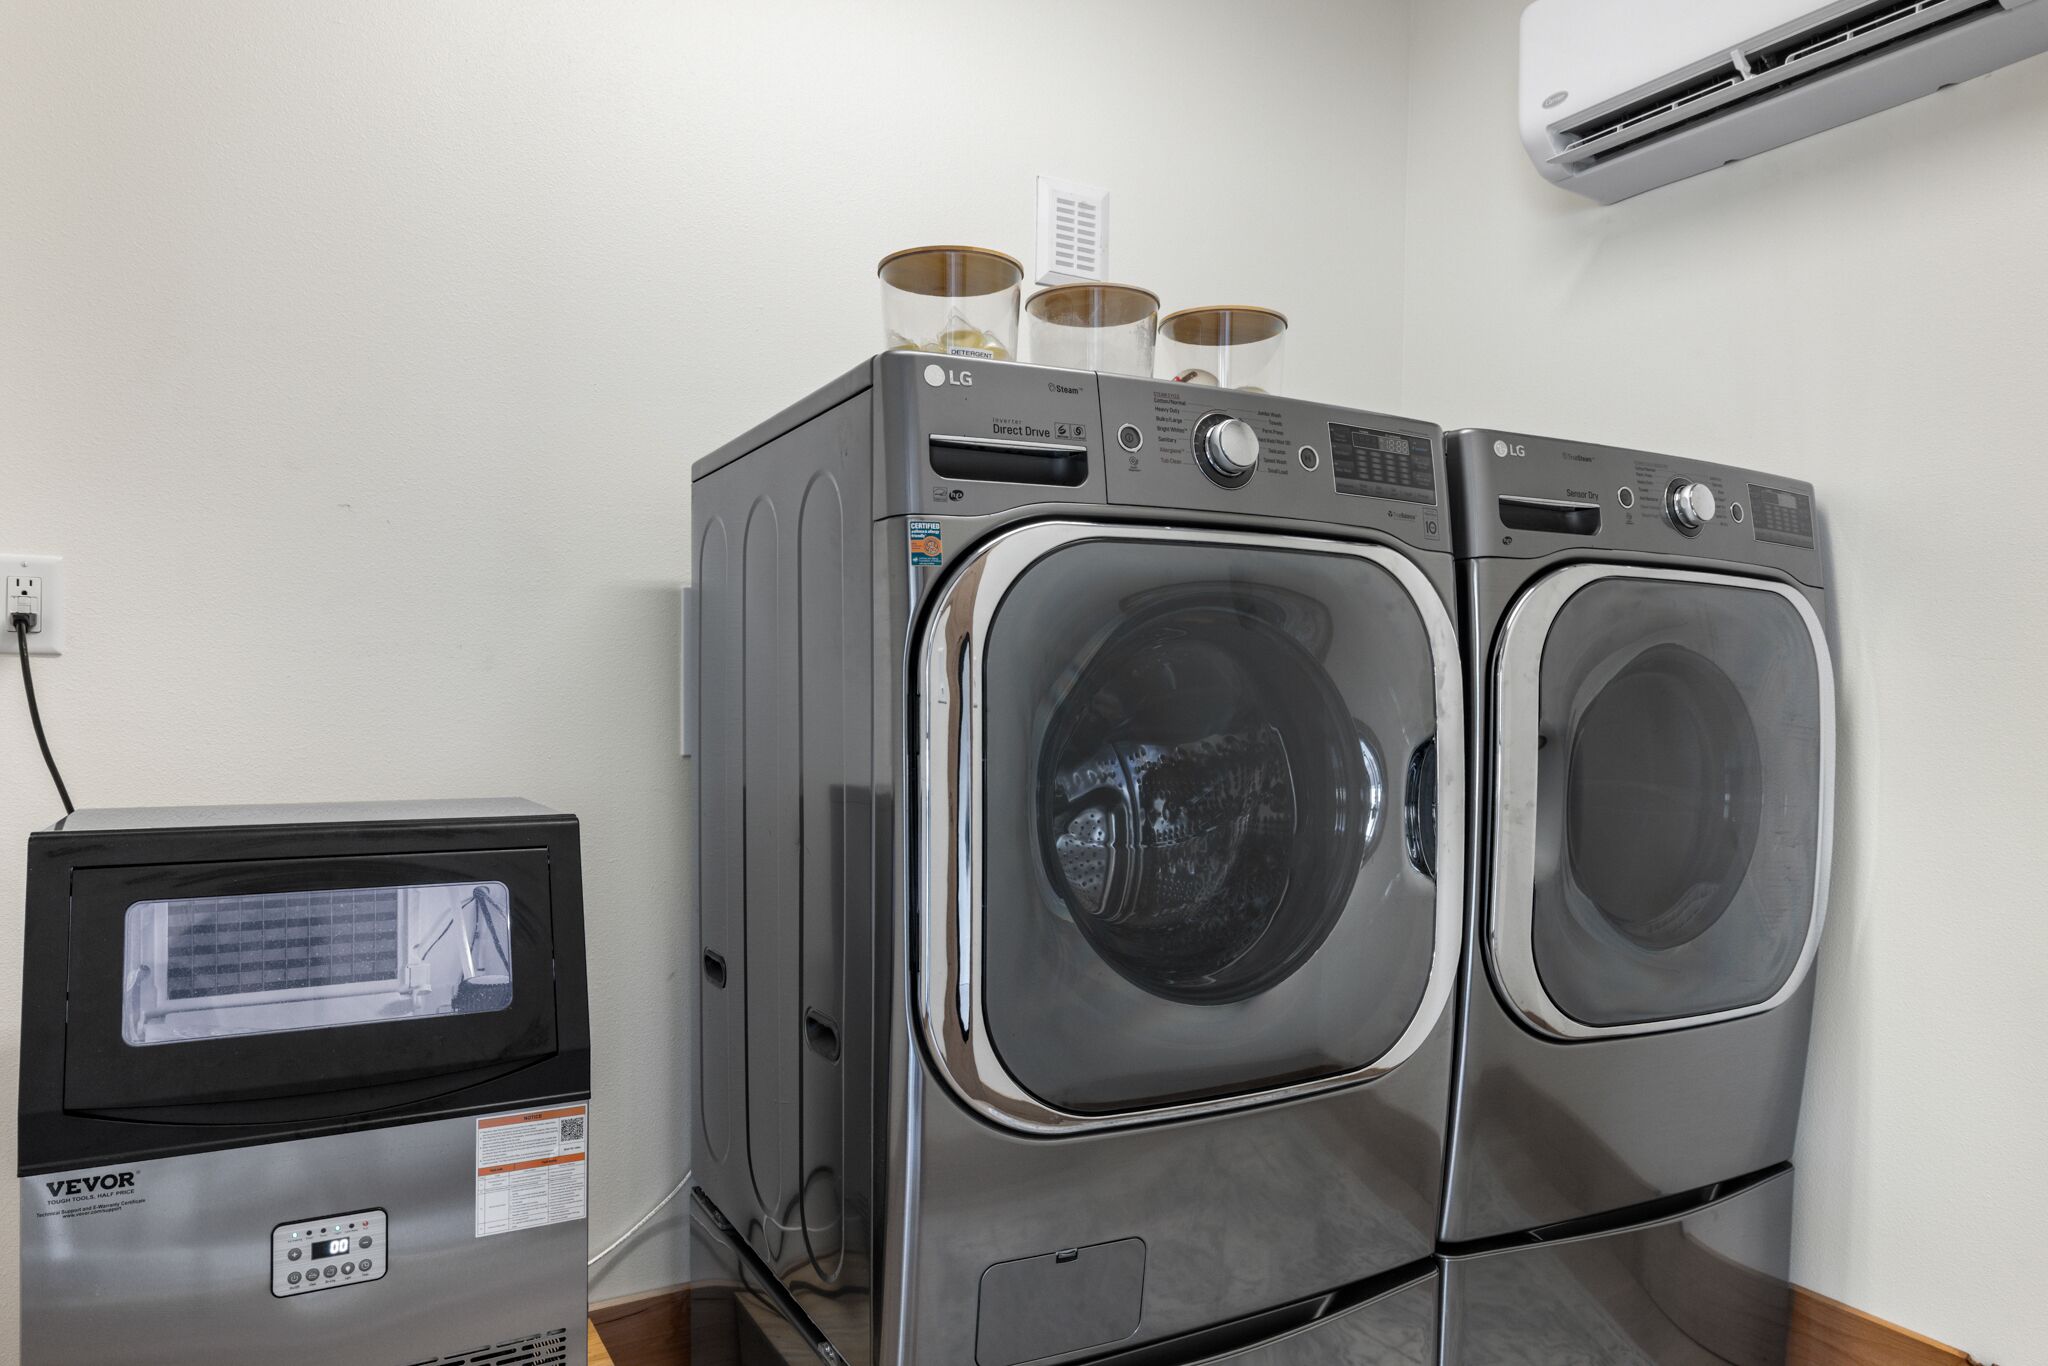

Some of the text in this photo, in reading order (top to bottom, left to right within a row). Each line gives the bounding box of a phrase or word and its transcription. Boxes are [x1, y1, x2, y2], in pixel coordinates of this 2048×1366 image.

[951, 349, 993, 359] DETERGENT
[949, 370, 973, 386] LG
[993, 424, 1051, 438] Direct Drive
[1509, 444, 1526, 457] LG
[1567, 488, 1599, 501] Sensor Dry
[46, 1172, 135, 1197] VEVOR
[329, 1238, 349, 1255] 00
